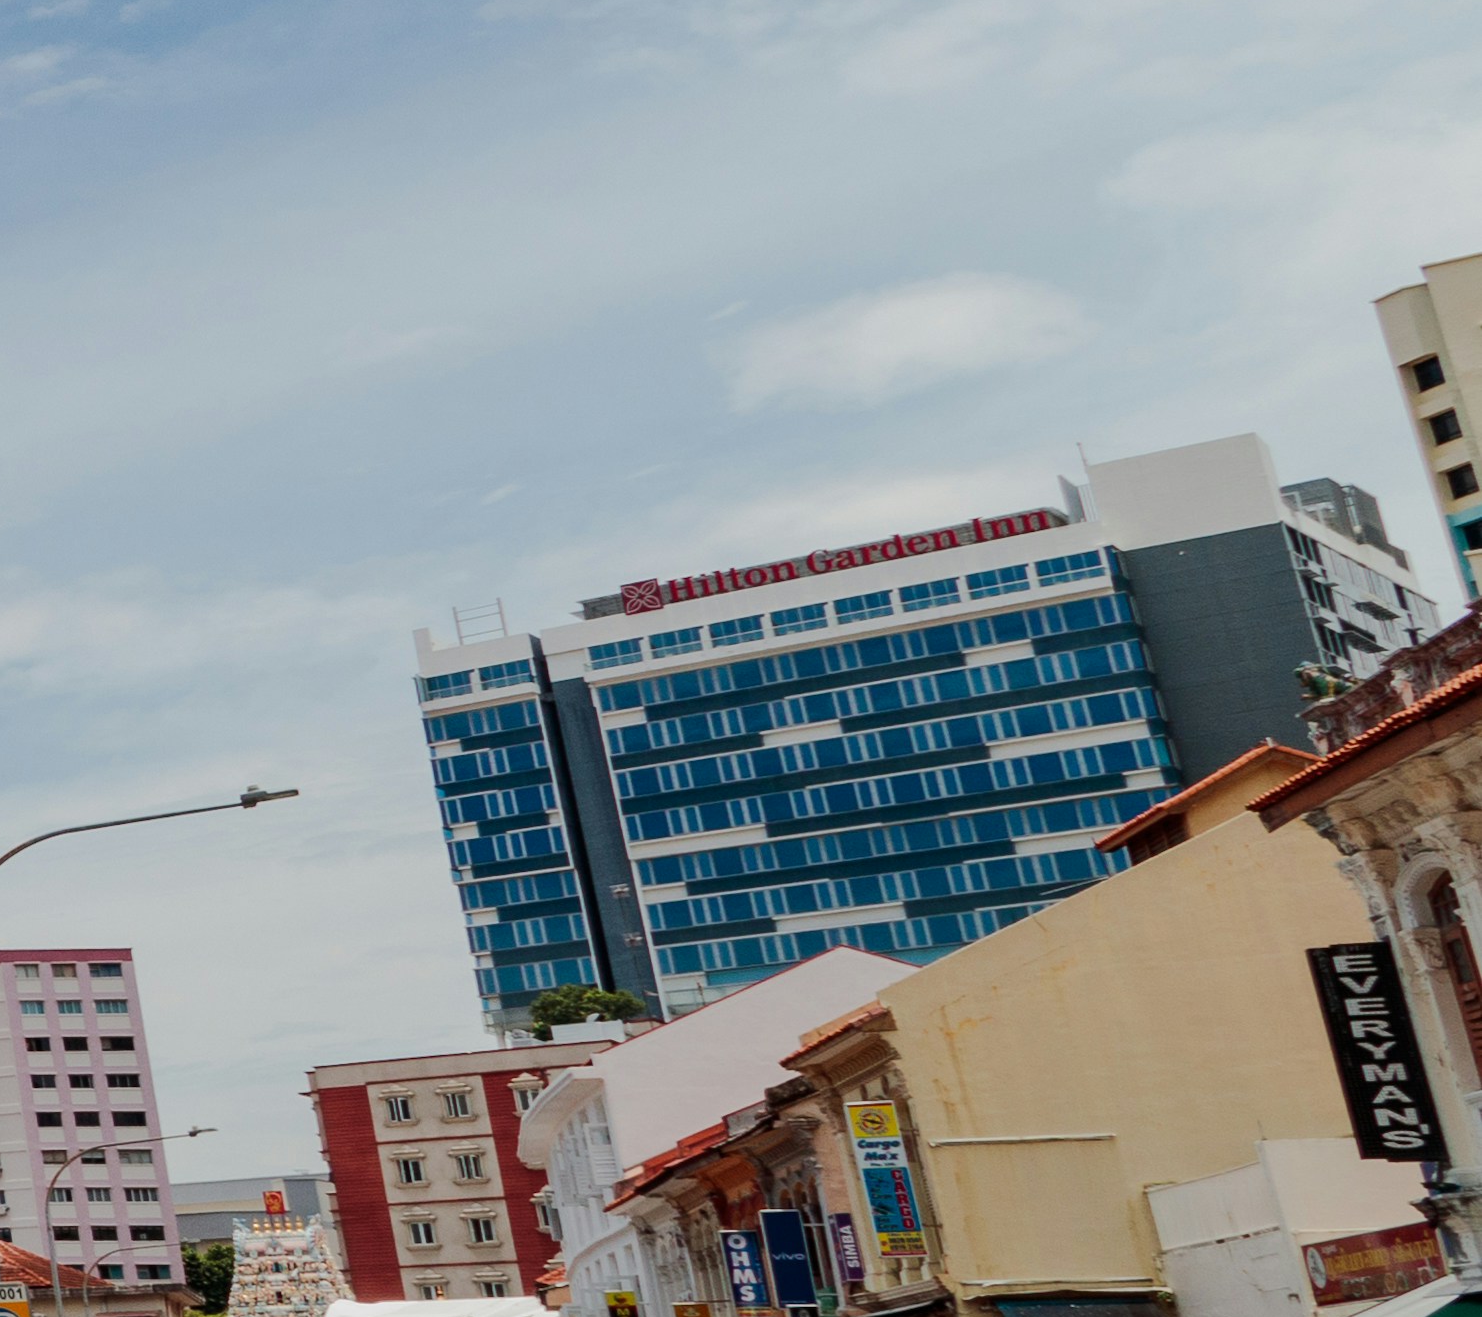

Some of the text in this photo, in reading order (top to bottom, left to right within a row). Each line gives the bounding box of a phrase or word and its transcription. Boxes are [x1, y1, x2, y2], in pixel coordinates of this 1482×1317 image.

[669, 507, 1050, 604] Hilton Garden Inn
[1333, 954, 1424, 1150] EVERYMAN'S
[858, 1140, 900, 1150] Cargo
[864, 1152, 898, 1161] Max
[891, 1169, 916, 1230] CARGO
[727, 1234, 758, 1302] OHMS
[772, 1252, 806, 1261] vivo
[842, 1225, 860, 1269] SIMBA
